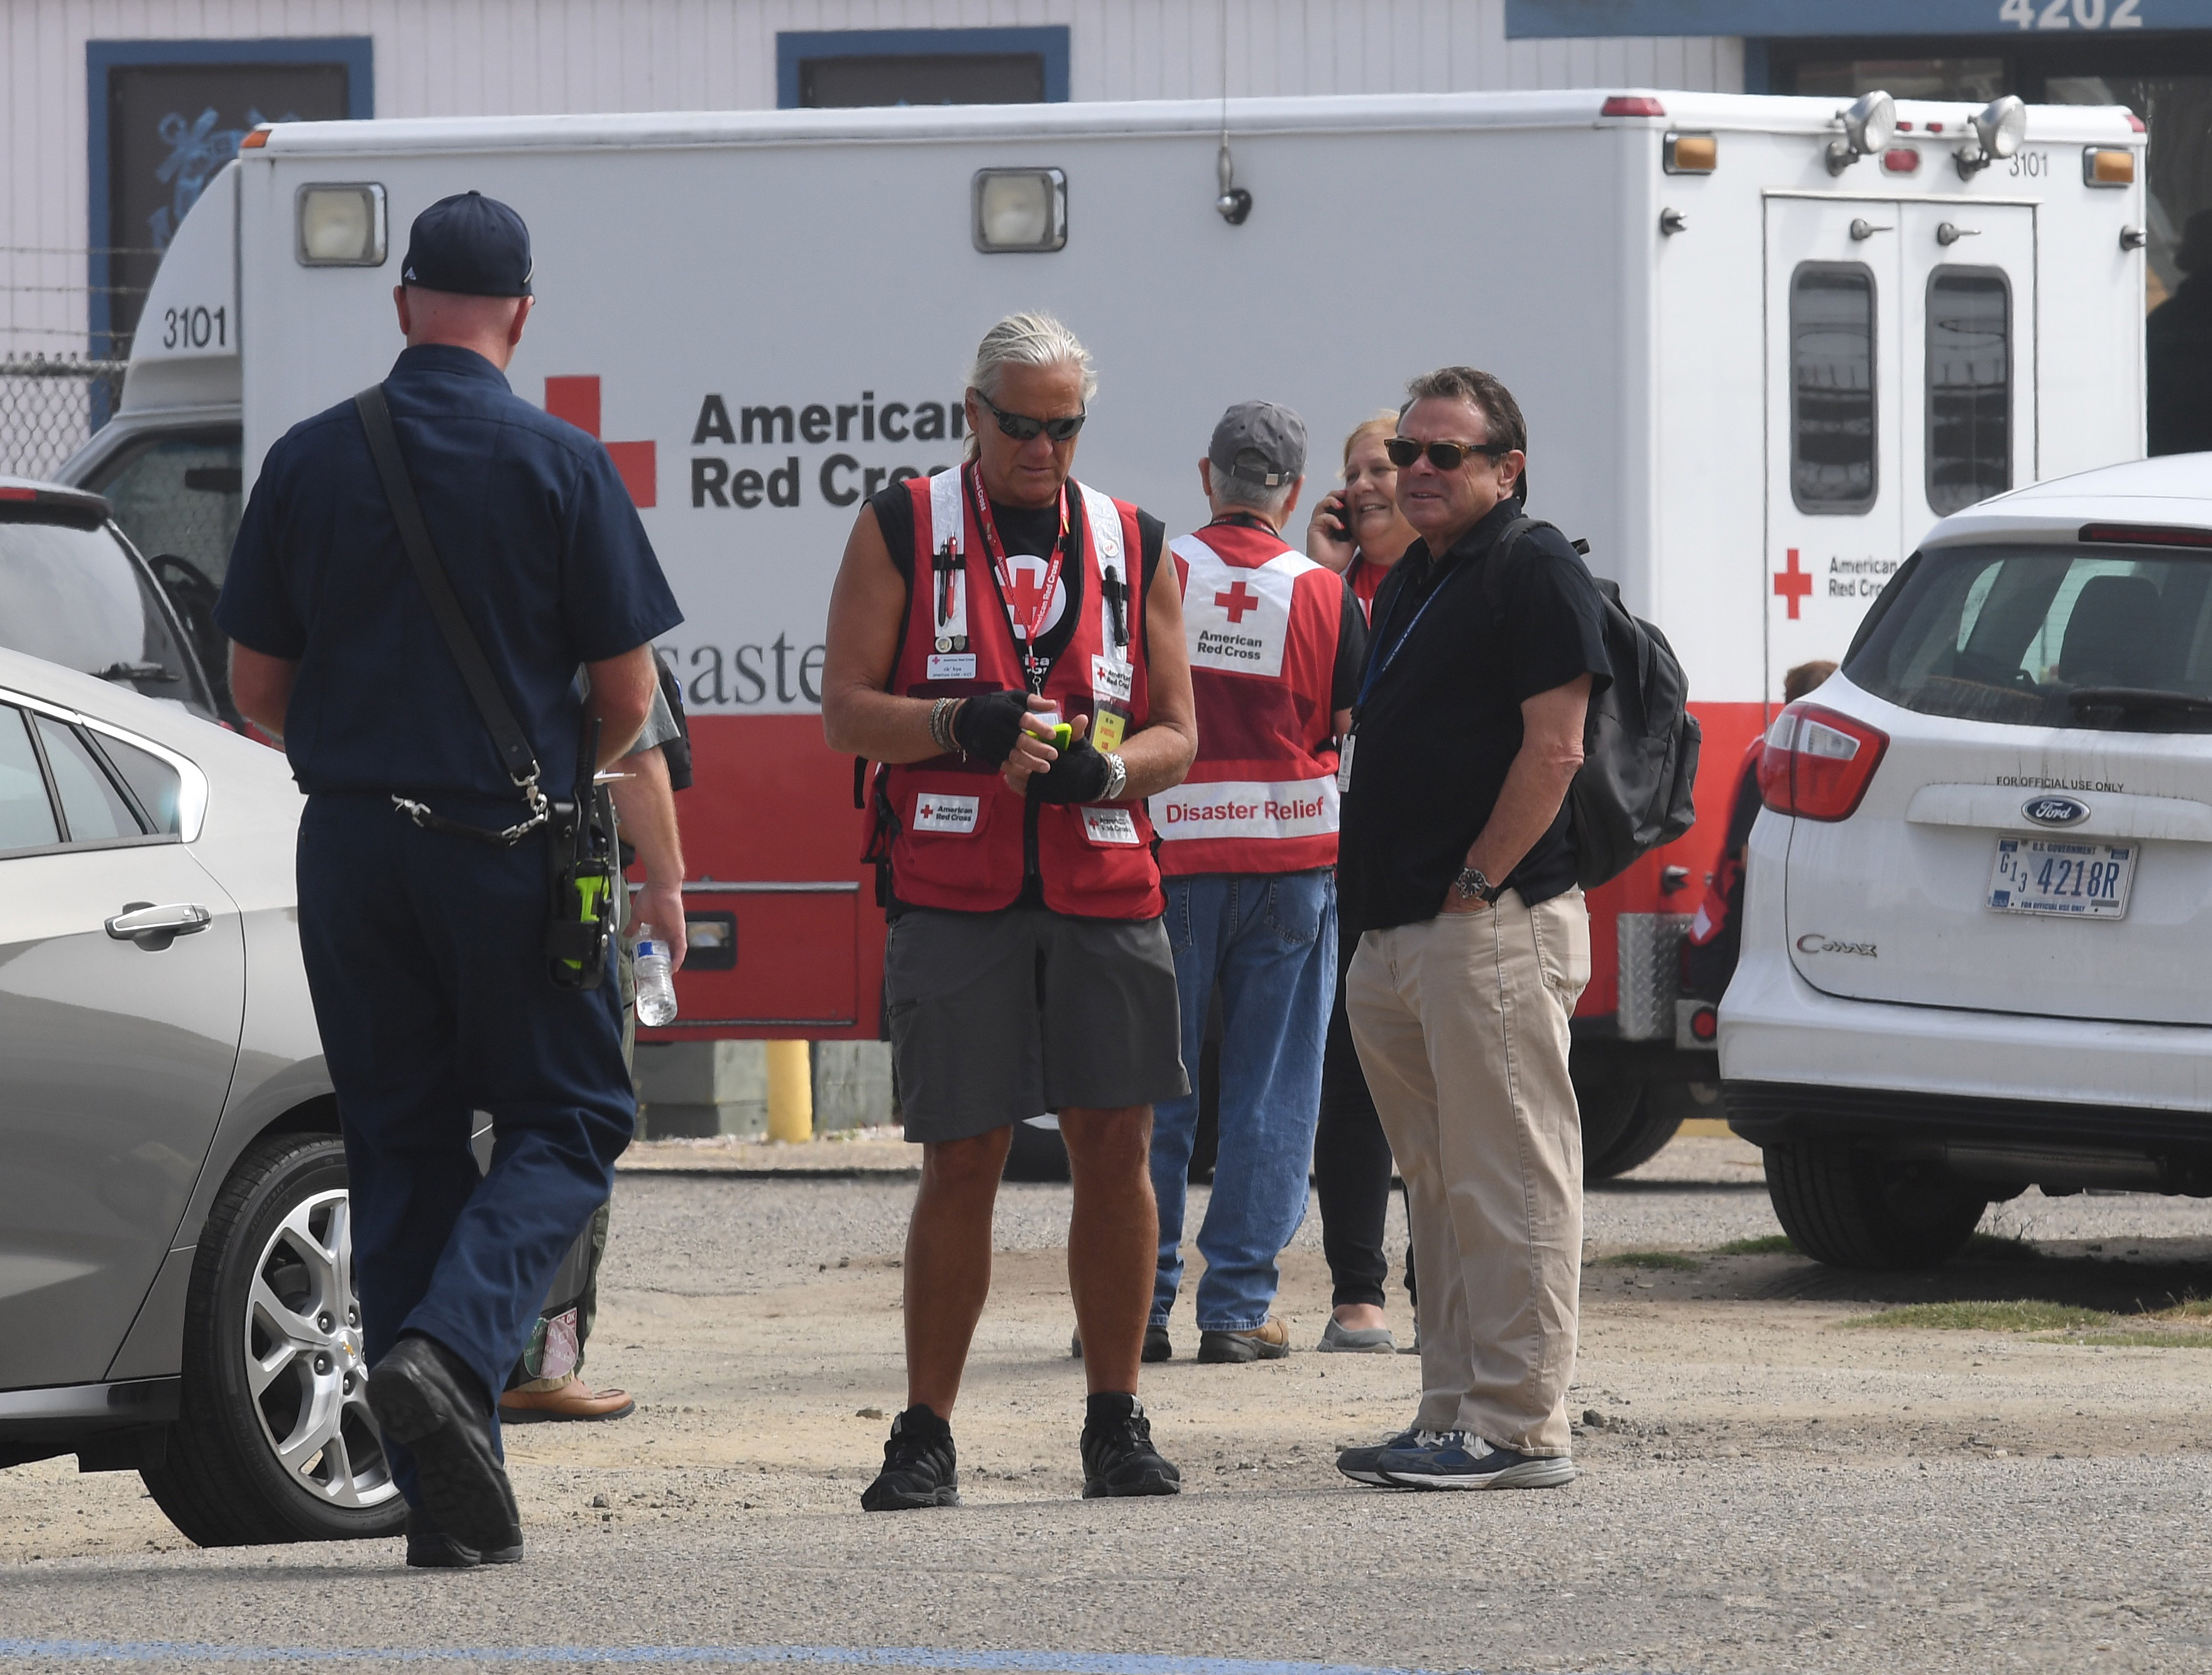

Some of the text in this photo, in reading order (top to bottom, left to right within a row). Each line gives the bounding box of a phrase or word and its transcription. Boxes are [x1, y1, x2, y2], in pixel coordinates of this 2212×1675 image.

[1999, 0, 2143, 30] 4202
[2010, 152, 2048, 177] 3101
[163, 305, 226, 349] 3101
[692, 456, 799, 508] Red
[1829, 556, 1898, 573] American
[1043, 583, 1053, 600] Red
[1048, 559, 1059, 585] Cross
[1829, 578, 1885, 596] Red Cro
[1198, 630, 1262, 647] American
[1197, 642, 1261, 660] Red Cross
[1996, 777, 2124, 793] FOR OFFICIAL USE ONLY
[937, 805, 973, 813] American
[1166, 796, 1324, 823] Disaster Relief
[2035, 801, 2072, 819] Ford
[2032, 842, 2096, 855] U.S. GOVERNMENT
[2037, 857, 2120, 899] 4218R
